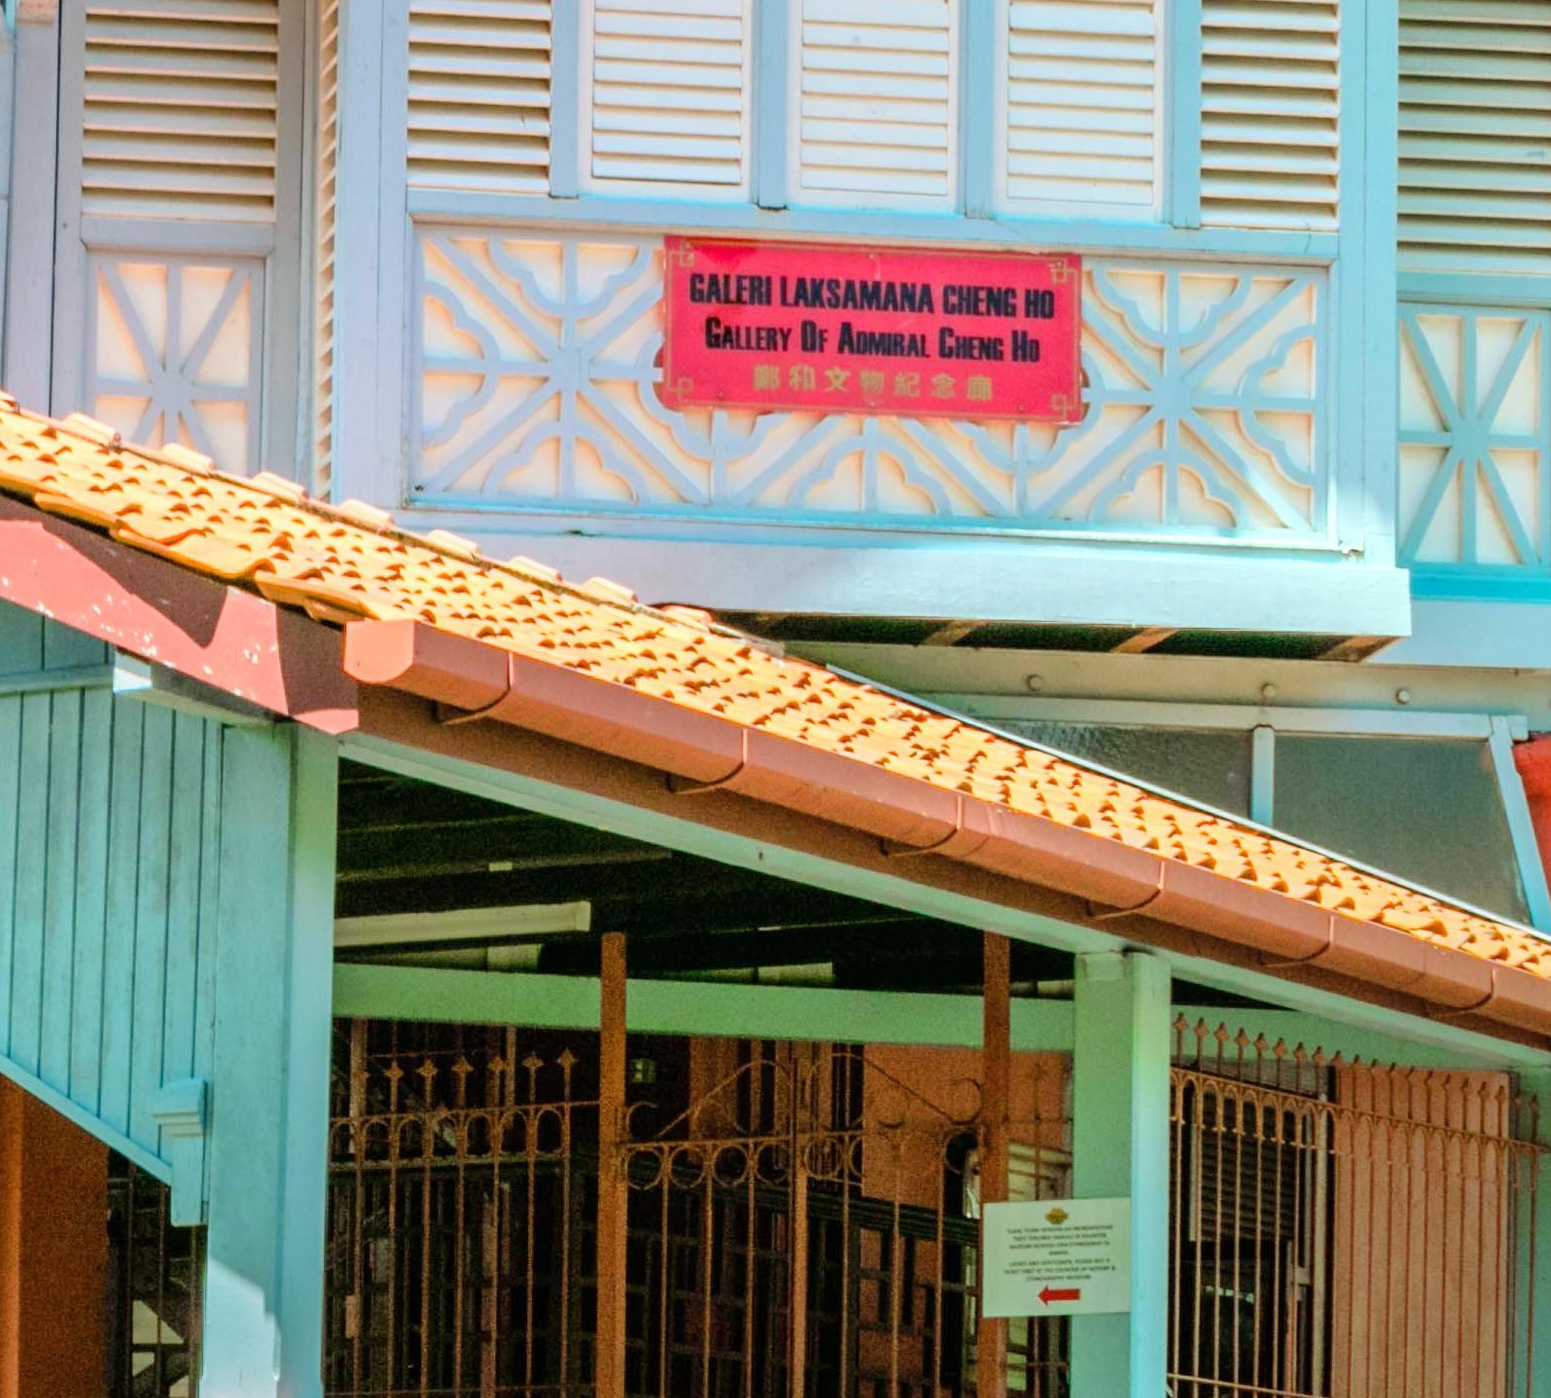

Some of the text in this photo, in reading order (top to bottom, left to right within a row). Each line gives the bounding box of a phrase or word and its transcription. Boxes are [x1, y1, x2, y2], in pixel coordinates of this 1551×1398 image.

[689, 273, 1055, 319] GALERI LAKSAMANA CHENG HO
